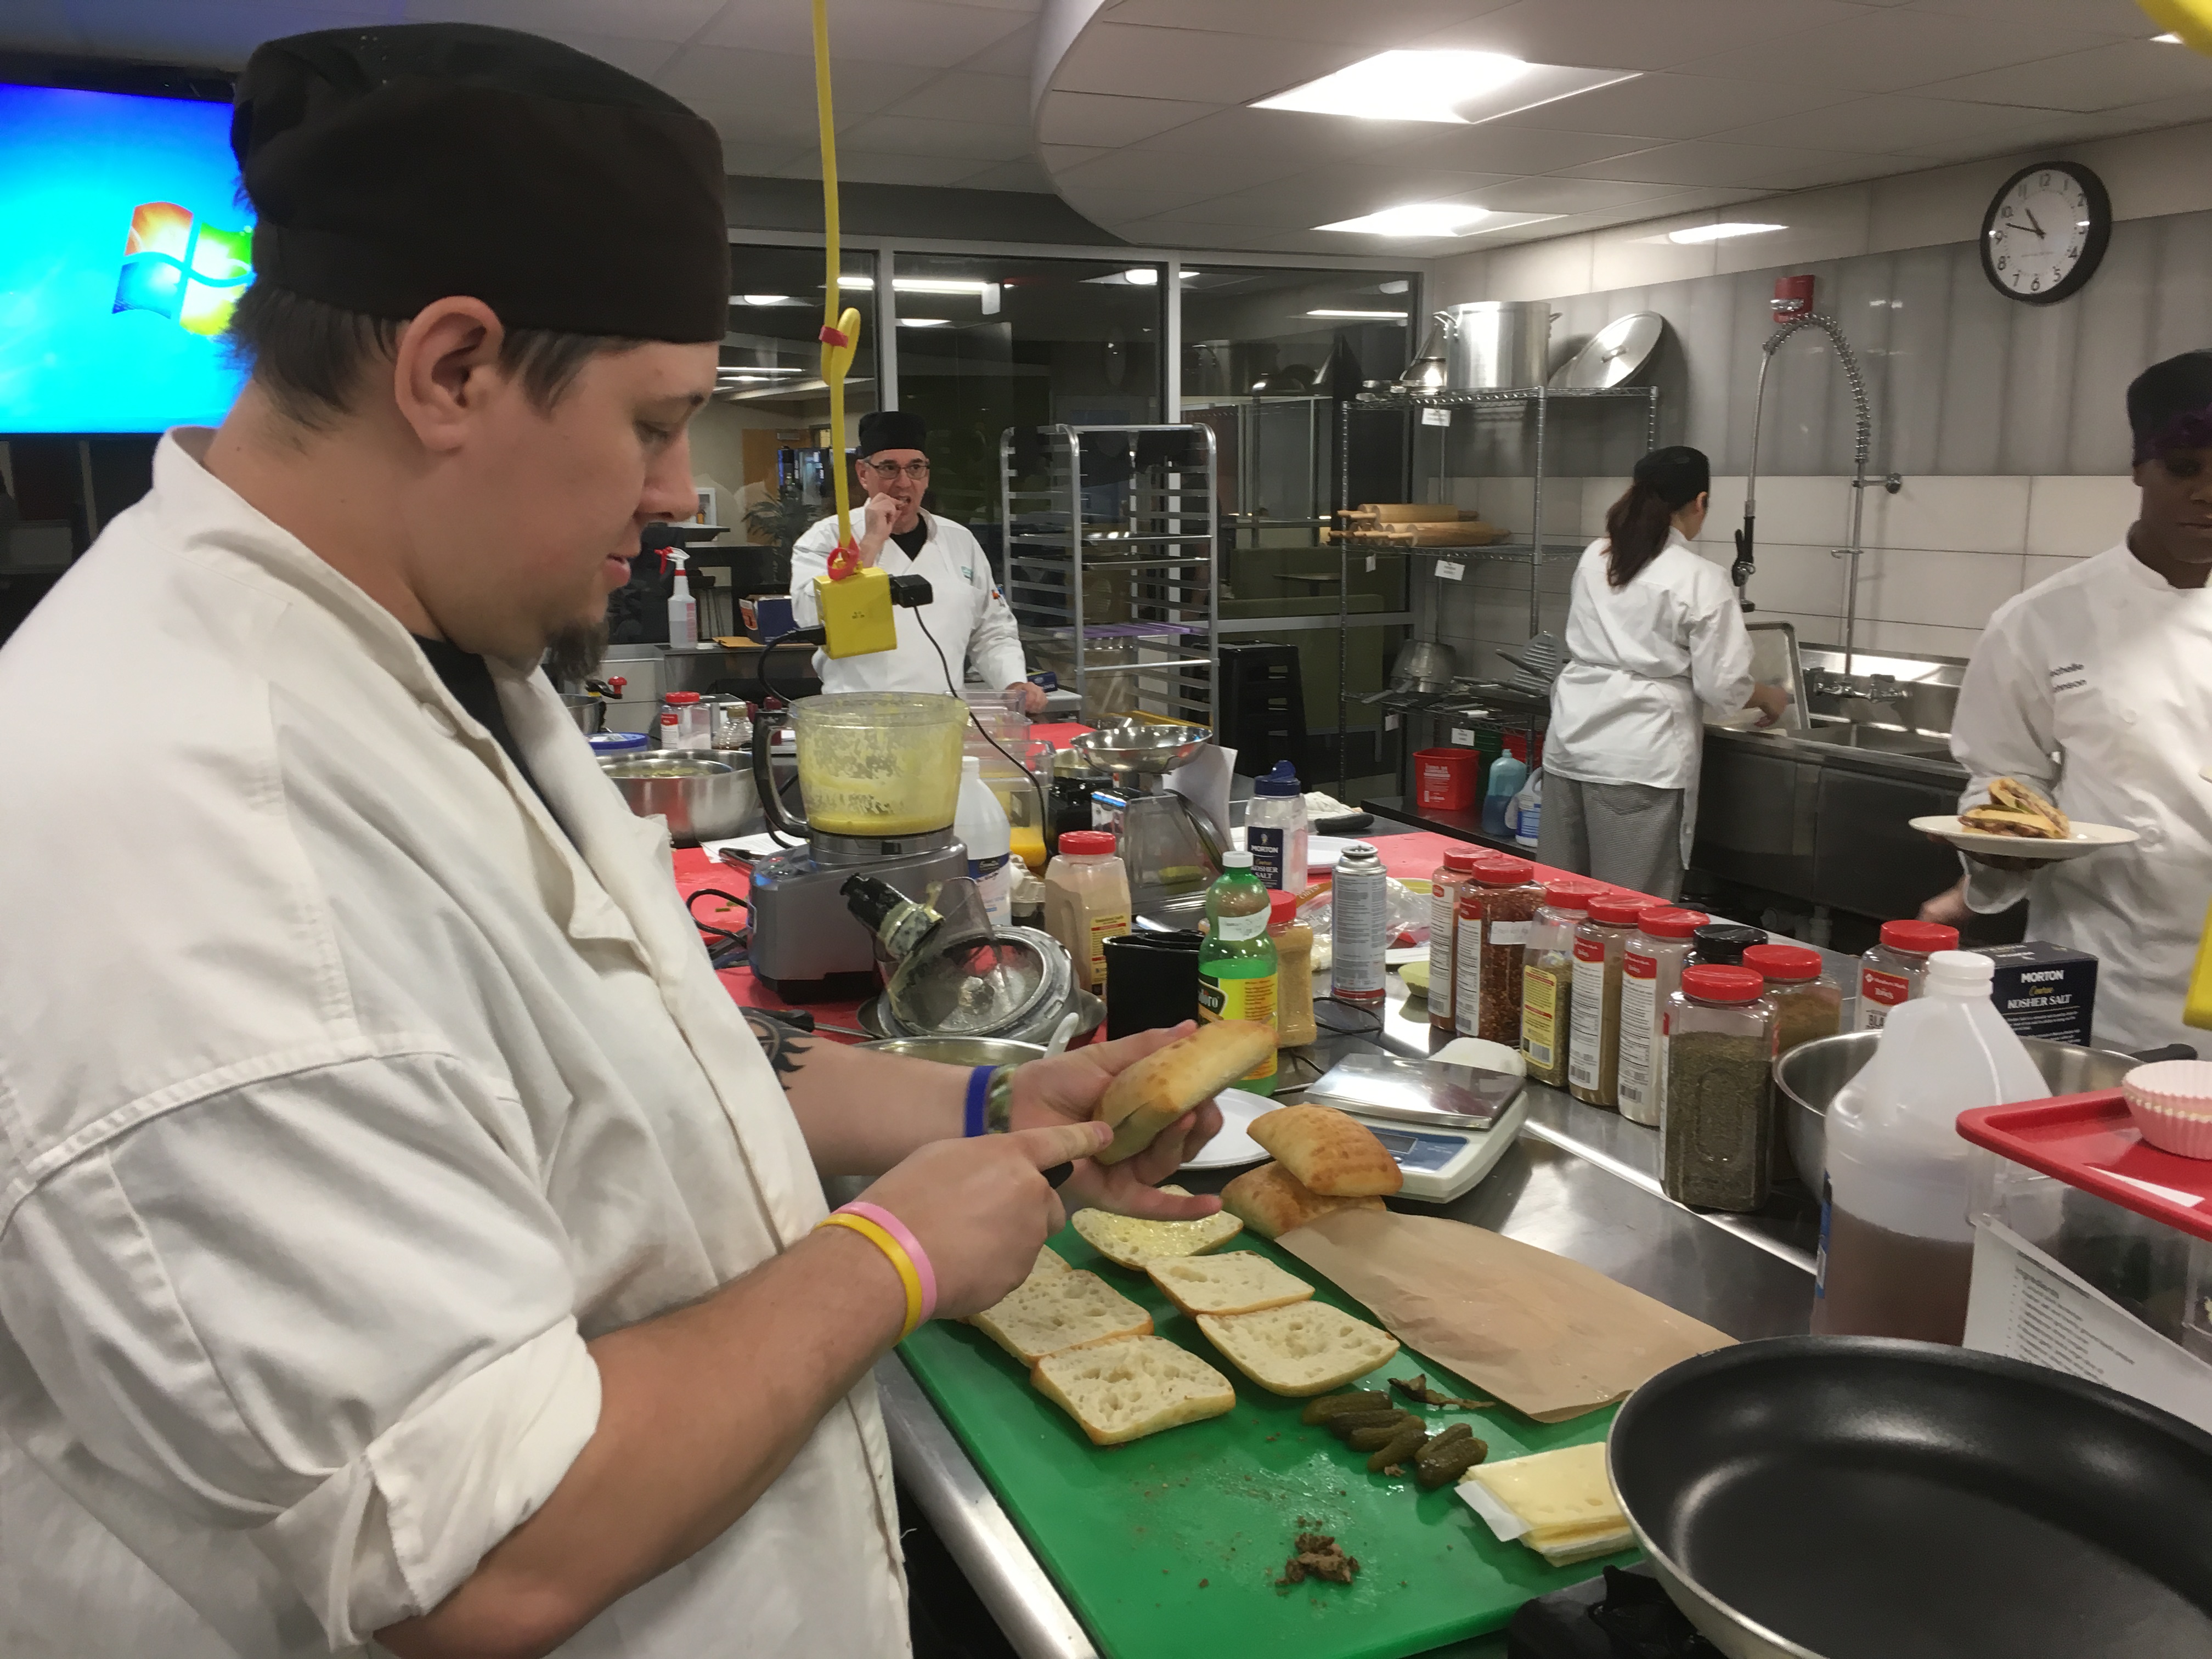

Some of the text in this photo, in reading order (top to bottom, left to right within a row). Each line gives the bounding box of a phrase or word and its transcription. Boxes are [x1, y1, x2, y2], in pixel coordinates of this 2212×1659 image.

[2039, 173, 2051, 187] 12
[2063, 178, 2069, 190] 1
[2018, 184, 2027, 198] 11
[2077, 193, 2085, 207] 2
[1995, 230, 2004, 245] 9
[2068, 246, 2079, 258] 4
[1997, 255, 2007, 270] 8
[2012, 273, 2020, 287] 7
[2053, 268, 2062, 283] 5
[2030, 276, 2041, 291] 6
[1251, 845, 1279, 853] MORTON
[2021, 969, 2065, 983] MORTON
[2007, 994, 2073, 1009] KOSHER SALT
